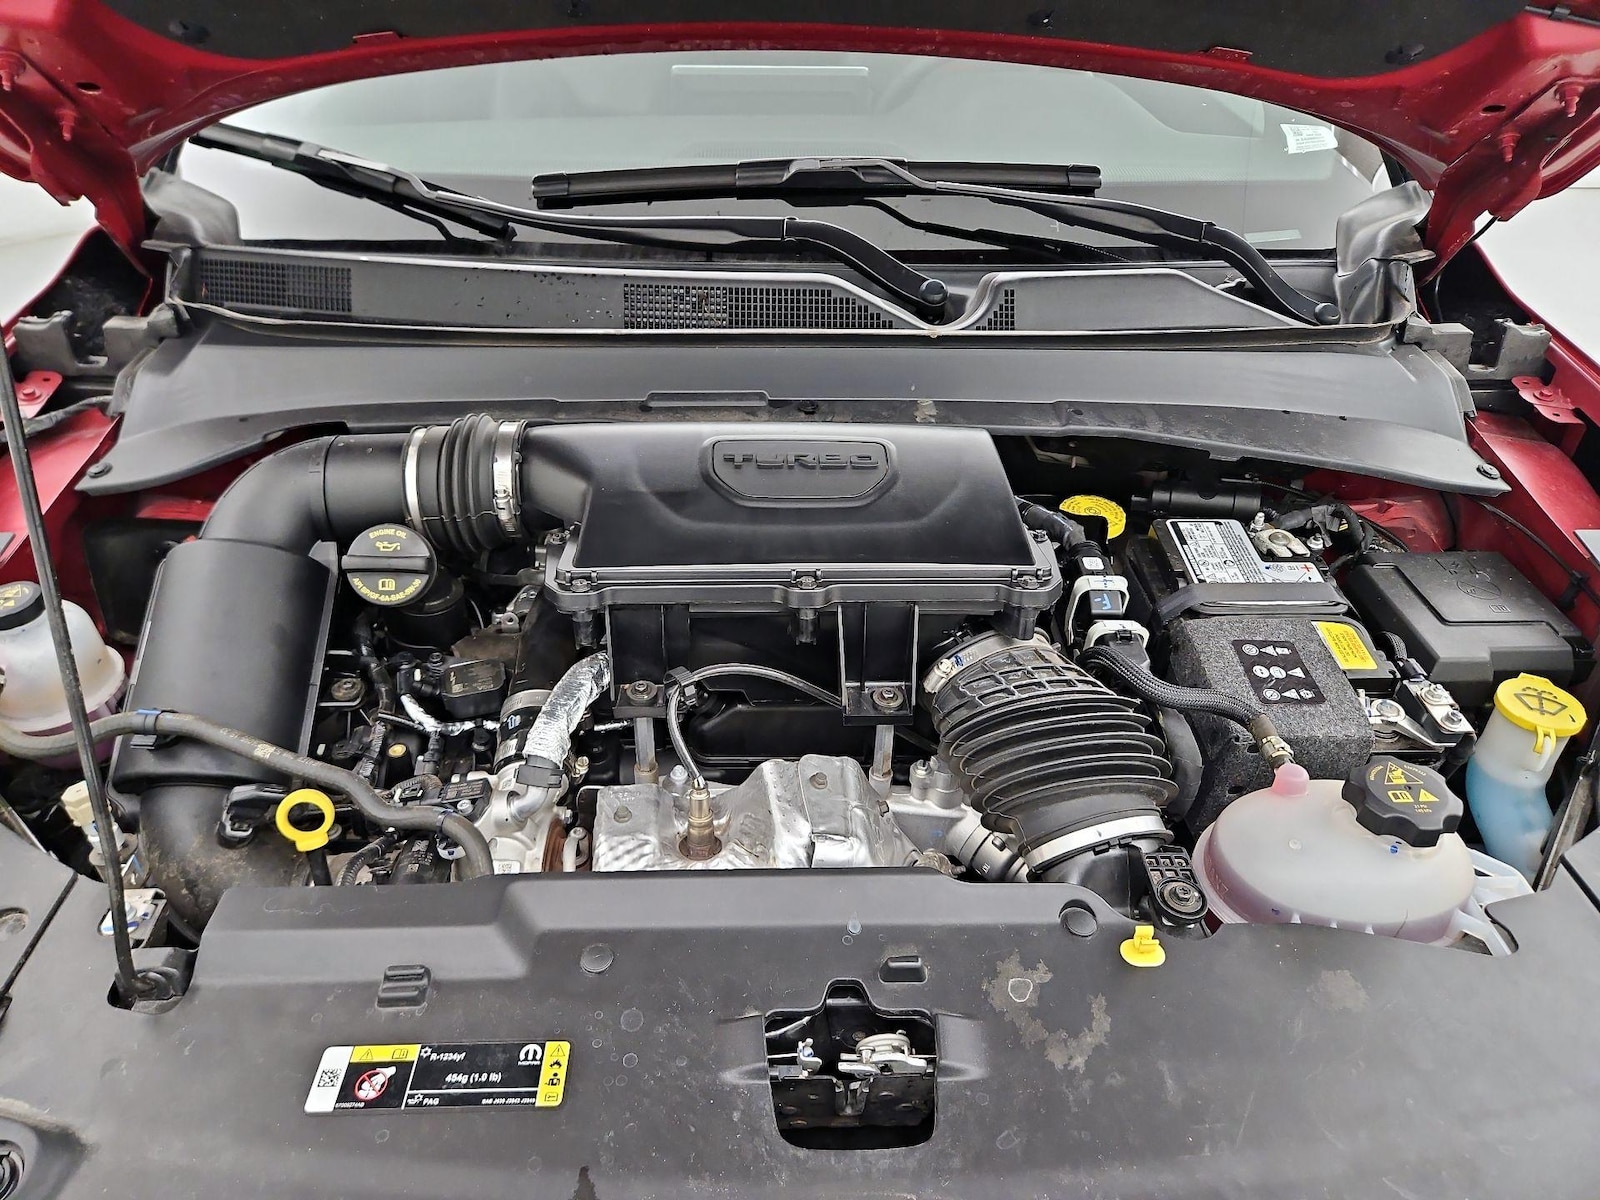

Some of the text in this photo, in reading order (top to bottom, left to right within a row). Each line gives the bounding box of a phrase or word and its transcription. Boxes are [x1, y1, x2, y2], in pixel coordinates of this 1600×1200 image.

[723, 454, 879, 470] TURBO
[369, 528, 407, 539] ENGINE OIL
[353, 578, 363, 589] API
[429, 1052, 466, 1062] R-1234yf
[444, 1072, 502, 1084] 454g (1.0 lb)
[422, 1097, 440, 1106] PAG
